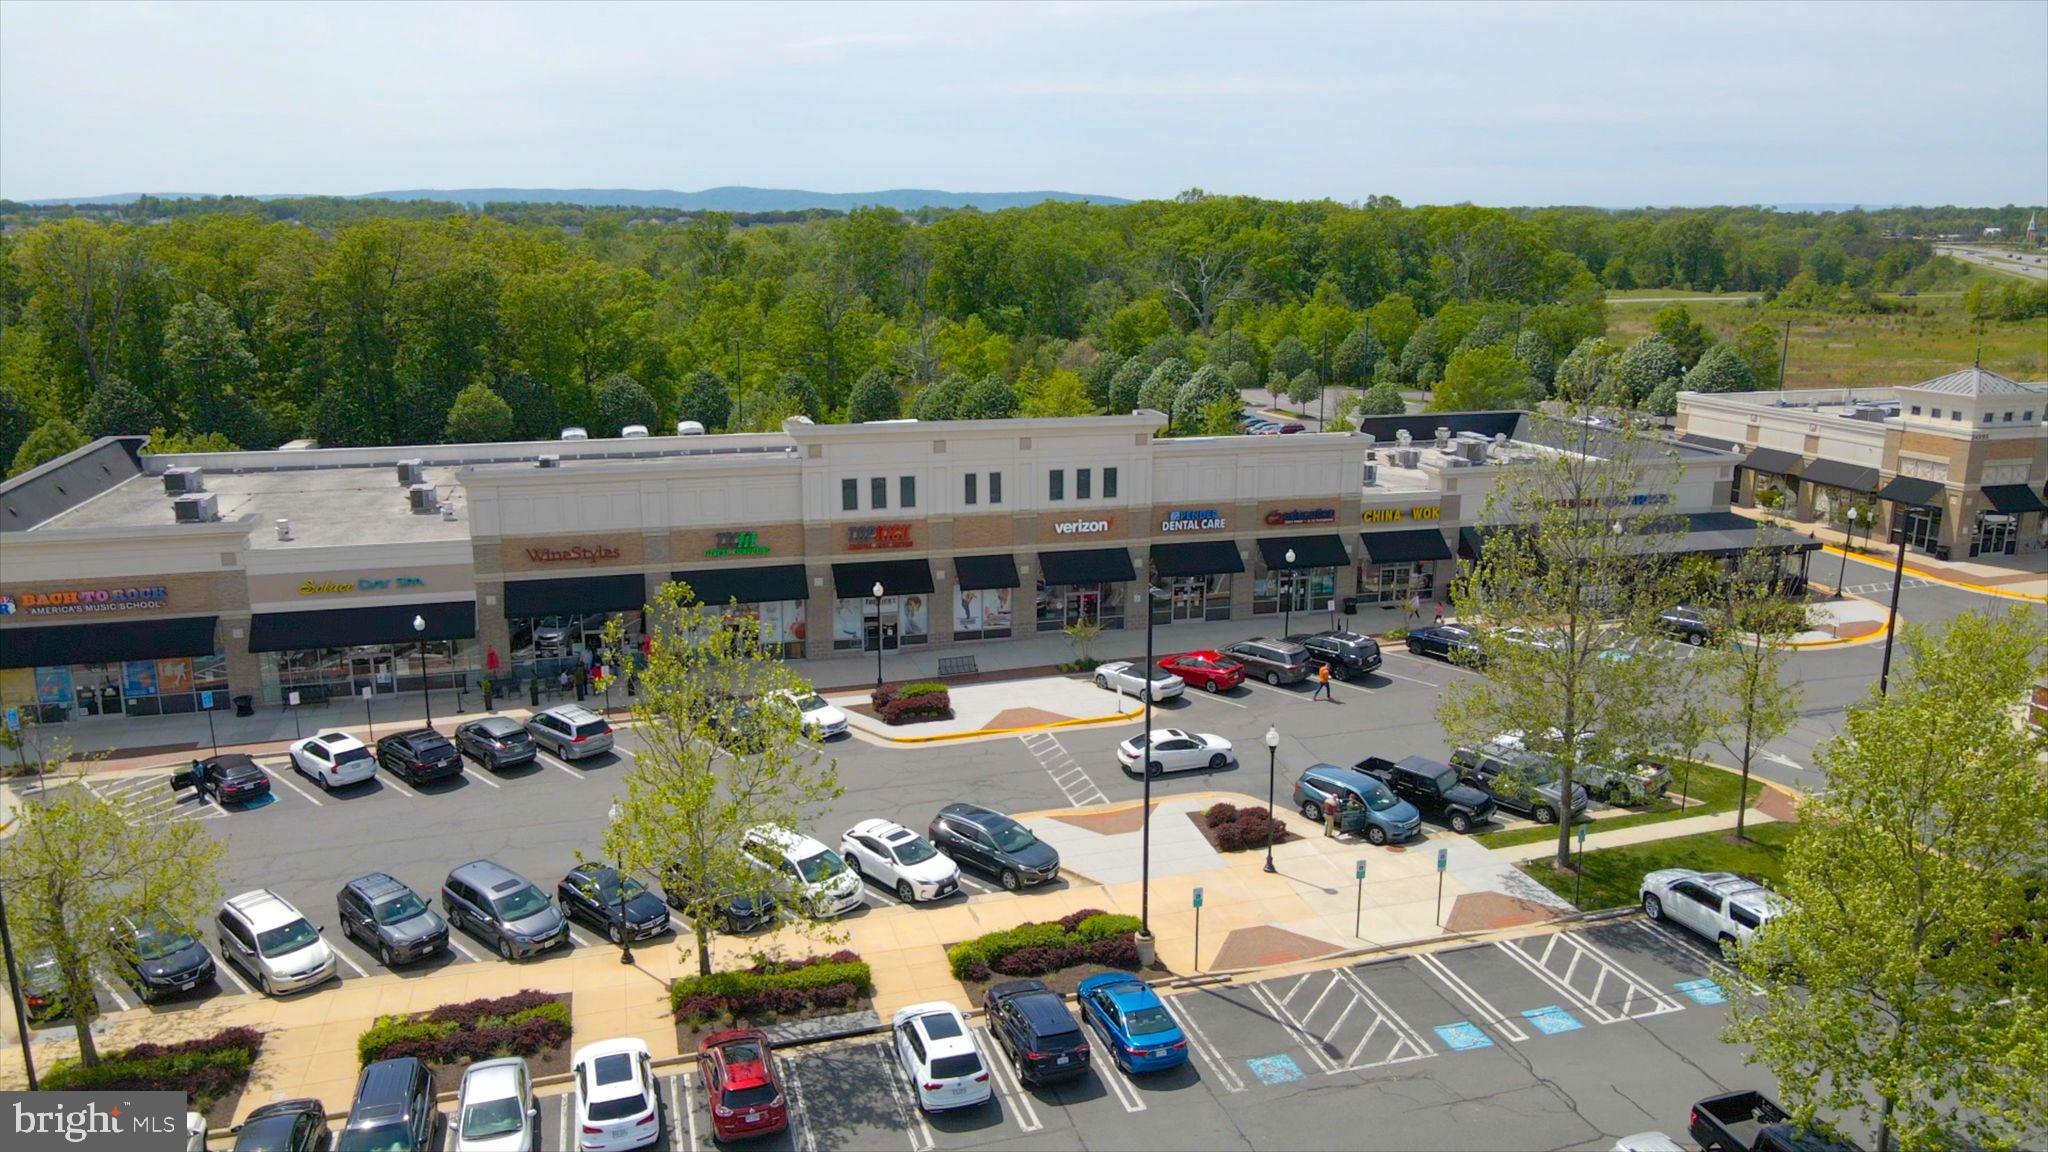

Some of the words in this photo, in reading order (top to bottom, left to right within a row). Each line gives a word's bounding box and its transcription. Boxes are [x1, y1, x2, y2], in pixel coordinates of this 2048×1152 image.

[1363, 509, 1401, 522] CHINA
[1412, 506, 1441, 520] WOK
[1055, 519, 1108, 533] verizon
[1162, 519, 1199, 531] DENTAL
[1201, 518, 1226, 529] CARE
[525, 545, 621, 563] WineStyles
[21, 591, 79, 605] BACH
[80, 589, 110, 602] TO
[111, 586, 168, 601] ROCK
[31, 605, 83, 615] AMERICA'S
[85, 603, 117, 612] MUSIC
[120, 601, 161, 610] SCHOOL
